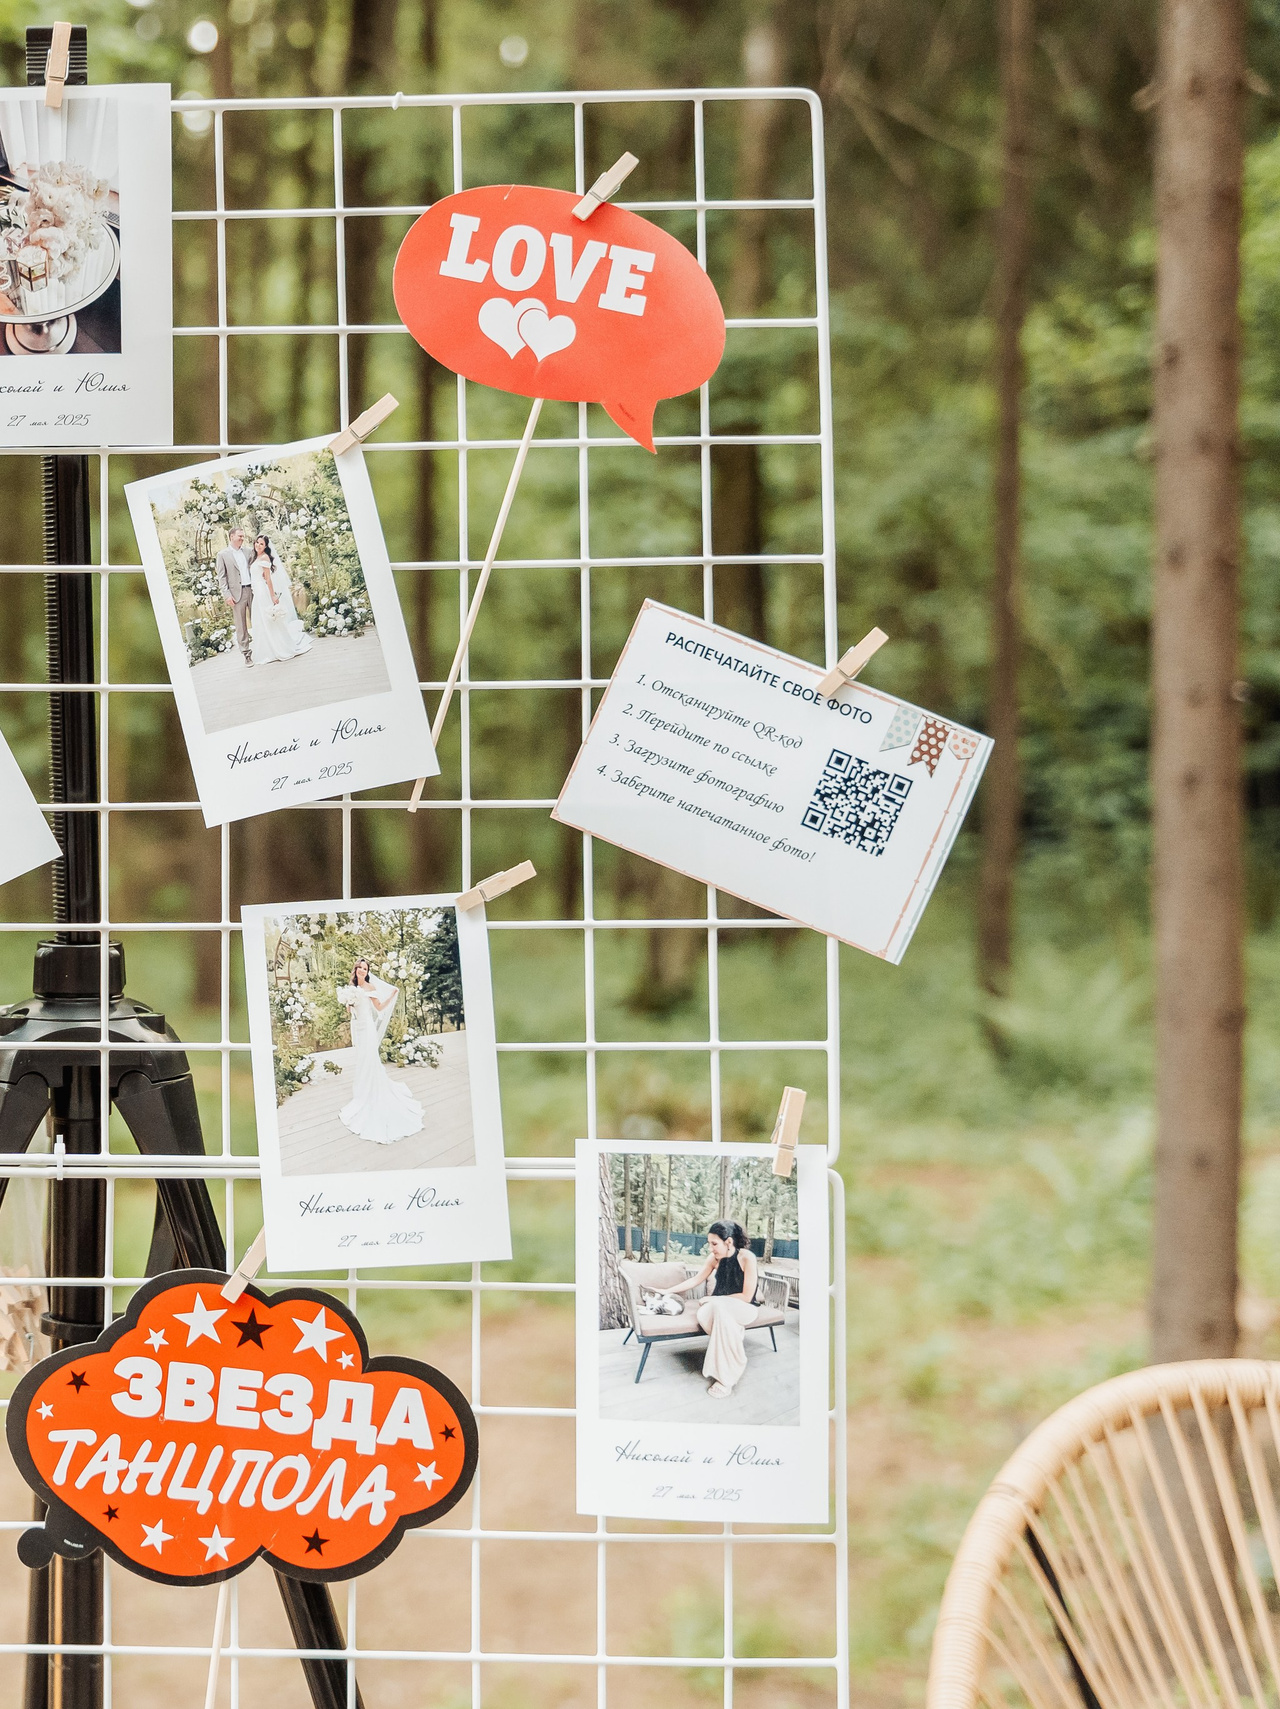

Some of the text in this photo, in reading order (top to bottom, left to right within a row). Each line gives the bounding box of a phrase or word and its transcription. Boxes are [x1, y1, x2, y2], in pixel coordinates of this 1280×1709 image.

[439, 213, 656, 317] LOVE
[52, 384, 66, 394] и
[74, 371, 131, 394] Юлия
[6, 413, 92, 427] 27 мая 2025
[665, 631, 873, 724] РАСПЕЧАТАЙТЕ СВОЕ ФОТО
[621, 703, 778, 778] 2. Перейдите по ссылке
[635, 673, 804, 749] 1. Отсканируйте QR-код
[226, 717, 387, 770] Николай и Юлия
[608, 733, 785, 814] 3. Загрузите фотографию
[270, 760, 354, 792] 27 мая 2025
[596, 764, 817, 863] 4. Заберите напечатанное фото!
[298, 1187, 464, 1218] Николай и Юлия
[337, 1234, 358, 1248] 27
[386, 1231, 425, 1245] 2025
[111, 1356, 434, 1456] ЗВЕЗДА
[47, 1428, 396, 1526] ТАНЦПОЛА
[614, 1439, 784, 1467] Николай и Юлия
[651, 1485, 674, 1498] 27
[703, 1487, 743, 1502] 2025
